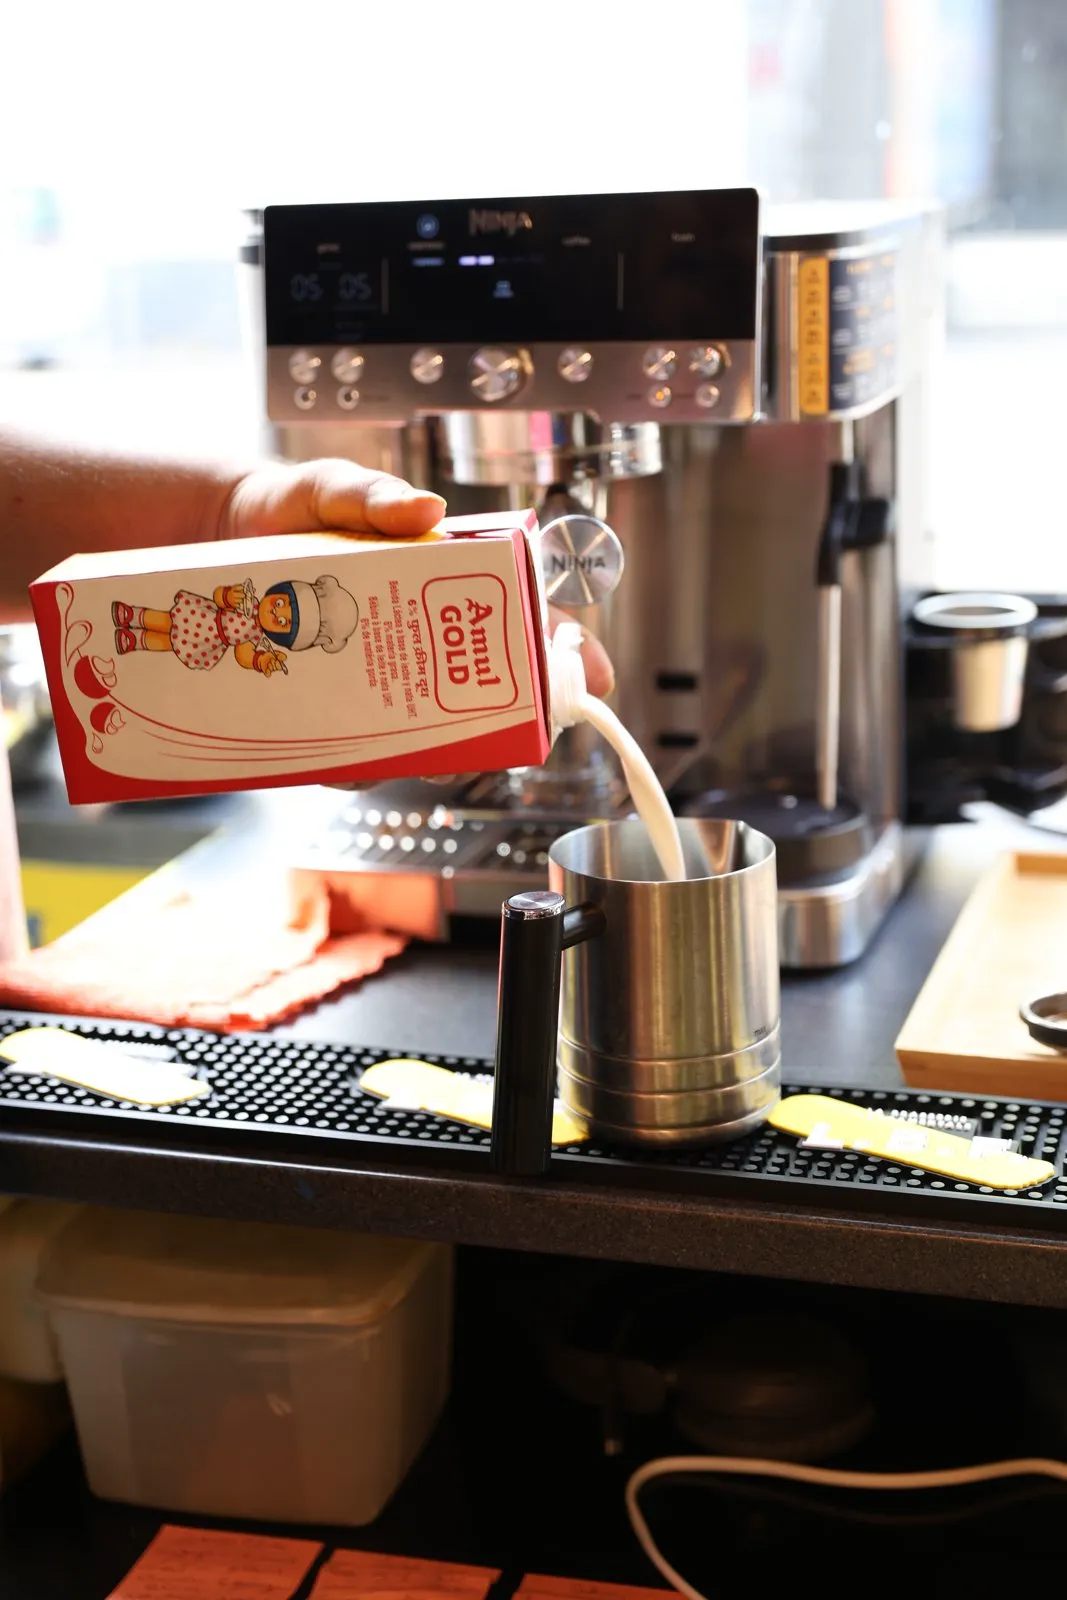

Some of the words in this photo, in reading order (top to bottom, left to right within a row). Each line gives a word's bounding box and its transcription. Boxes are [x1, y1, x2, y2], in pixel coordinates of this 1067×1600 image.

[551, 554, 606, 574] NINJA
[407, 598, 418, 616] 6%
[406, 618, 422, 644] फुल
[464, 597, 502, 688] Amul
[439, 604, 471, 686] GOLD
[413, 646, 428, 675] क्रीम
[414, 677, 429, 698] दूध
